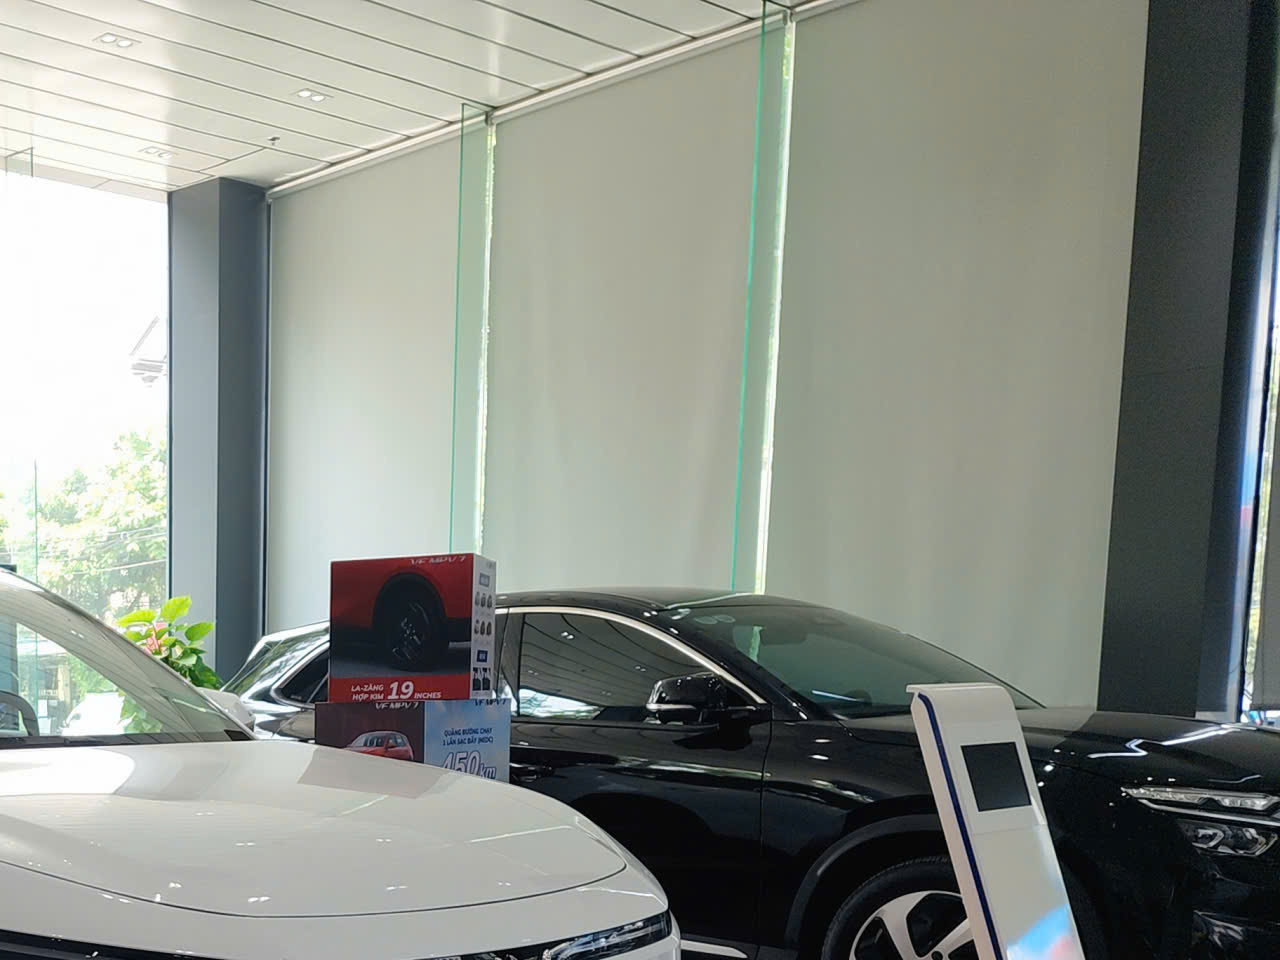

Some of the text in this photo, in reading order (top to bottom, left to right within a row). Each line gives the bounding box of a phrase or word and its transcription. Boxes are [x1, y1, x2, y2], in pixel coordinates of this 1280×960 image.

[370, 692, 384, 700] KIM
[387, 681, 414, 700] 19
[414, 691, 443, 700] INCHES
